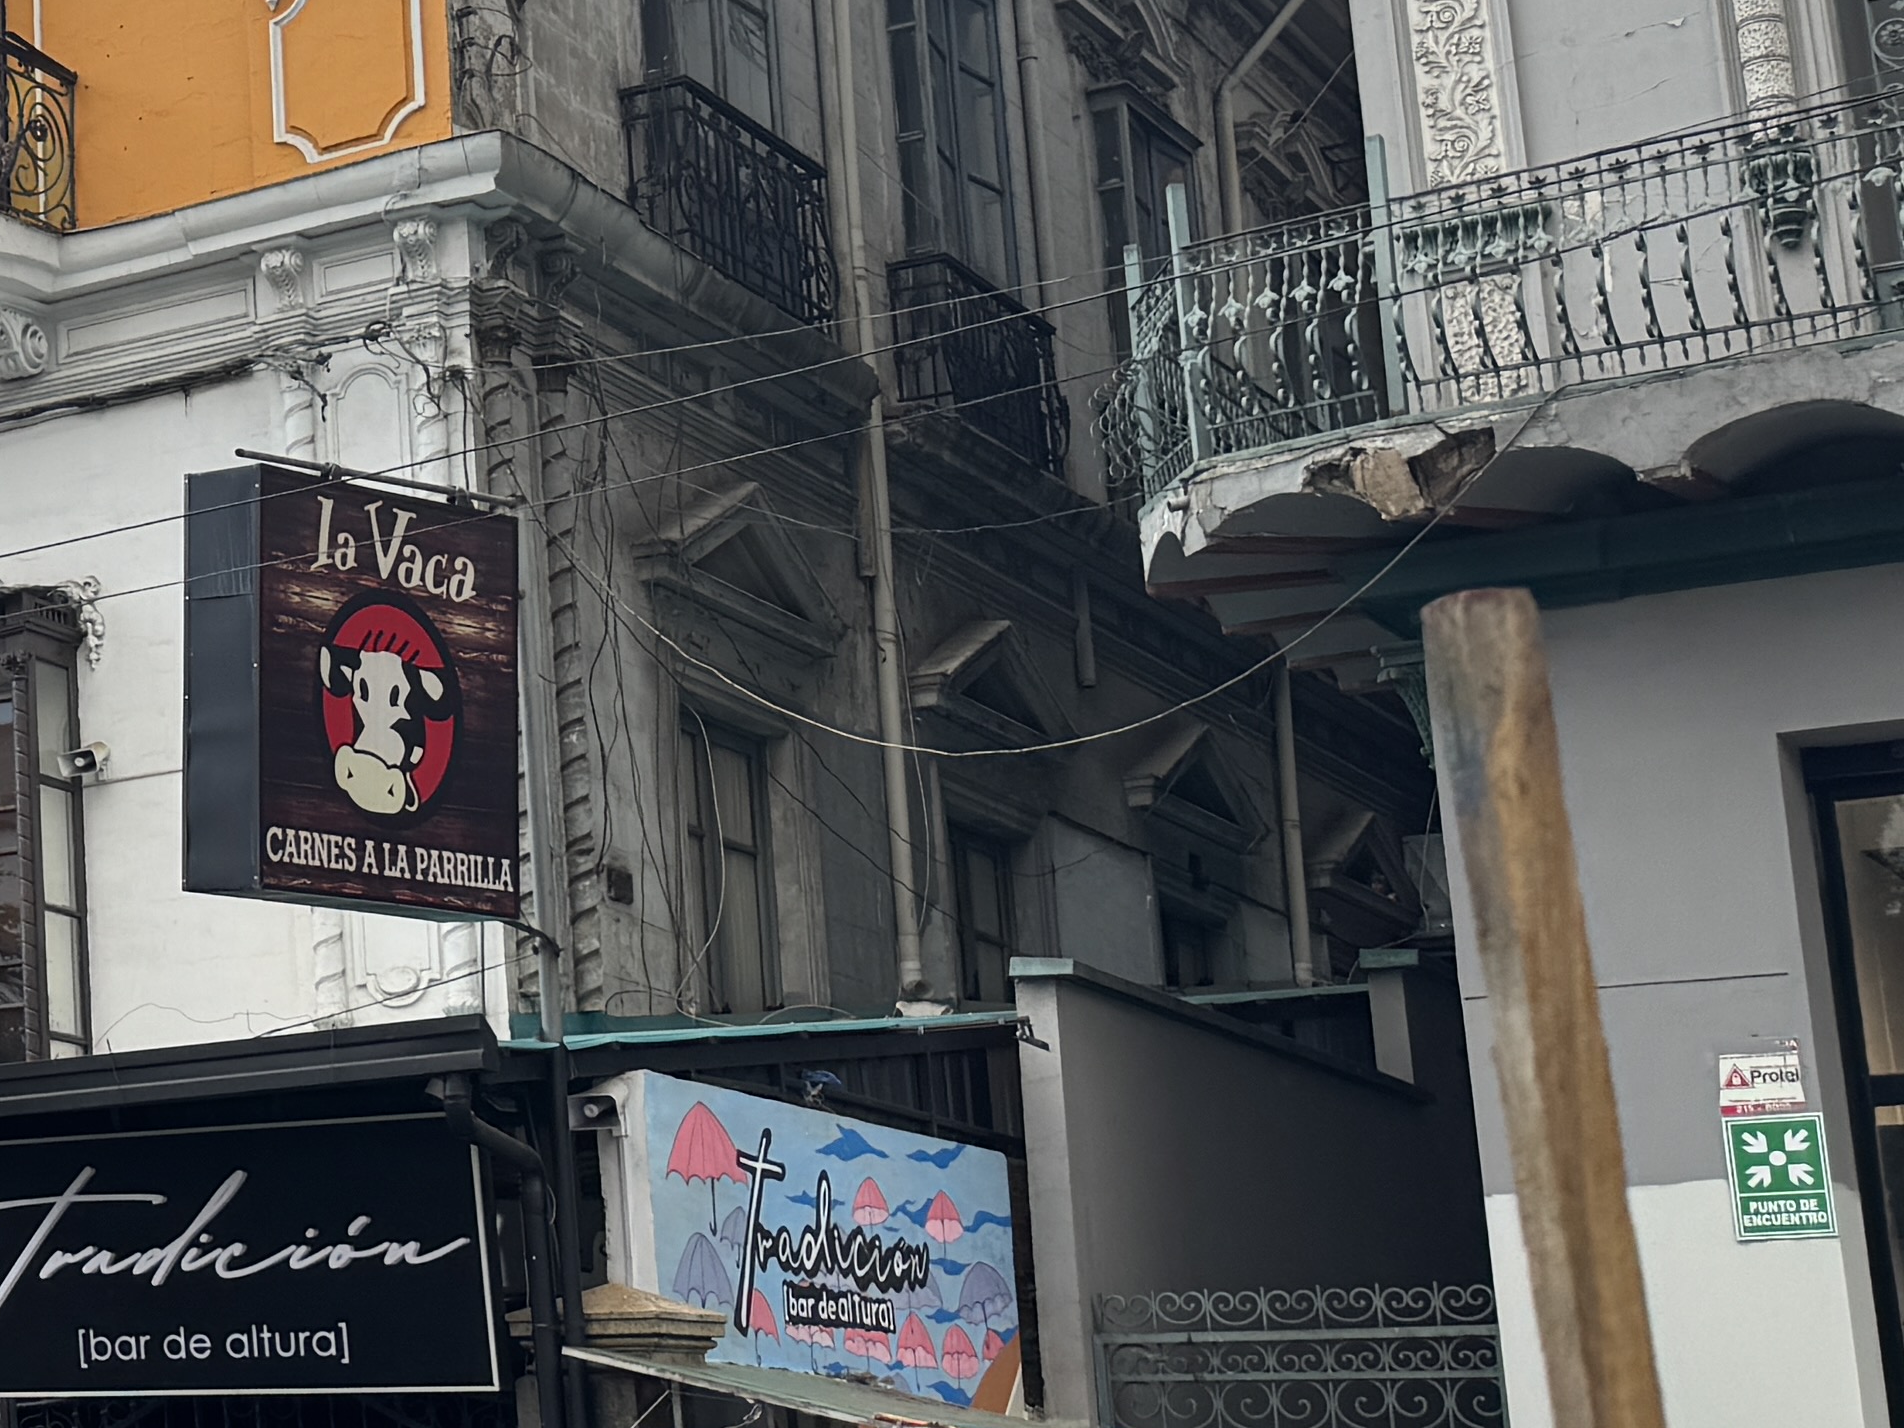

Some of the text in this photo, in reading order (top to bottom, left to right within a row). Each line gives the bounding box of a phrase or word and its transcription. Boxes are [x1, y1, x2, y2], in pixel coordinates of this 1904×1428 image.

[365, 500, 477, 603] Vaca
[266, 826, 514, 893] CARNES A LA PARRILLA
[1743, 1212, 1827, 1227] ENCUENTRO
[1750, 1199, 1819, 1212] PUNTO DE
[163, 1326, 211, 1359] de
